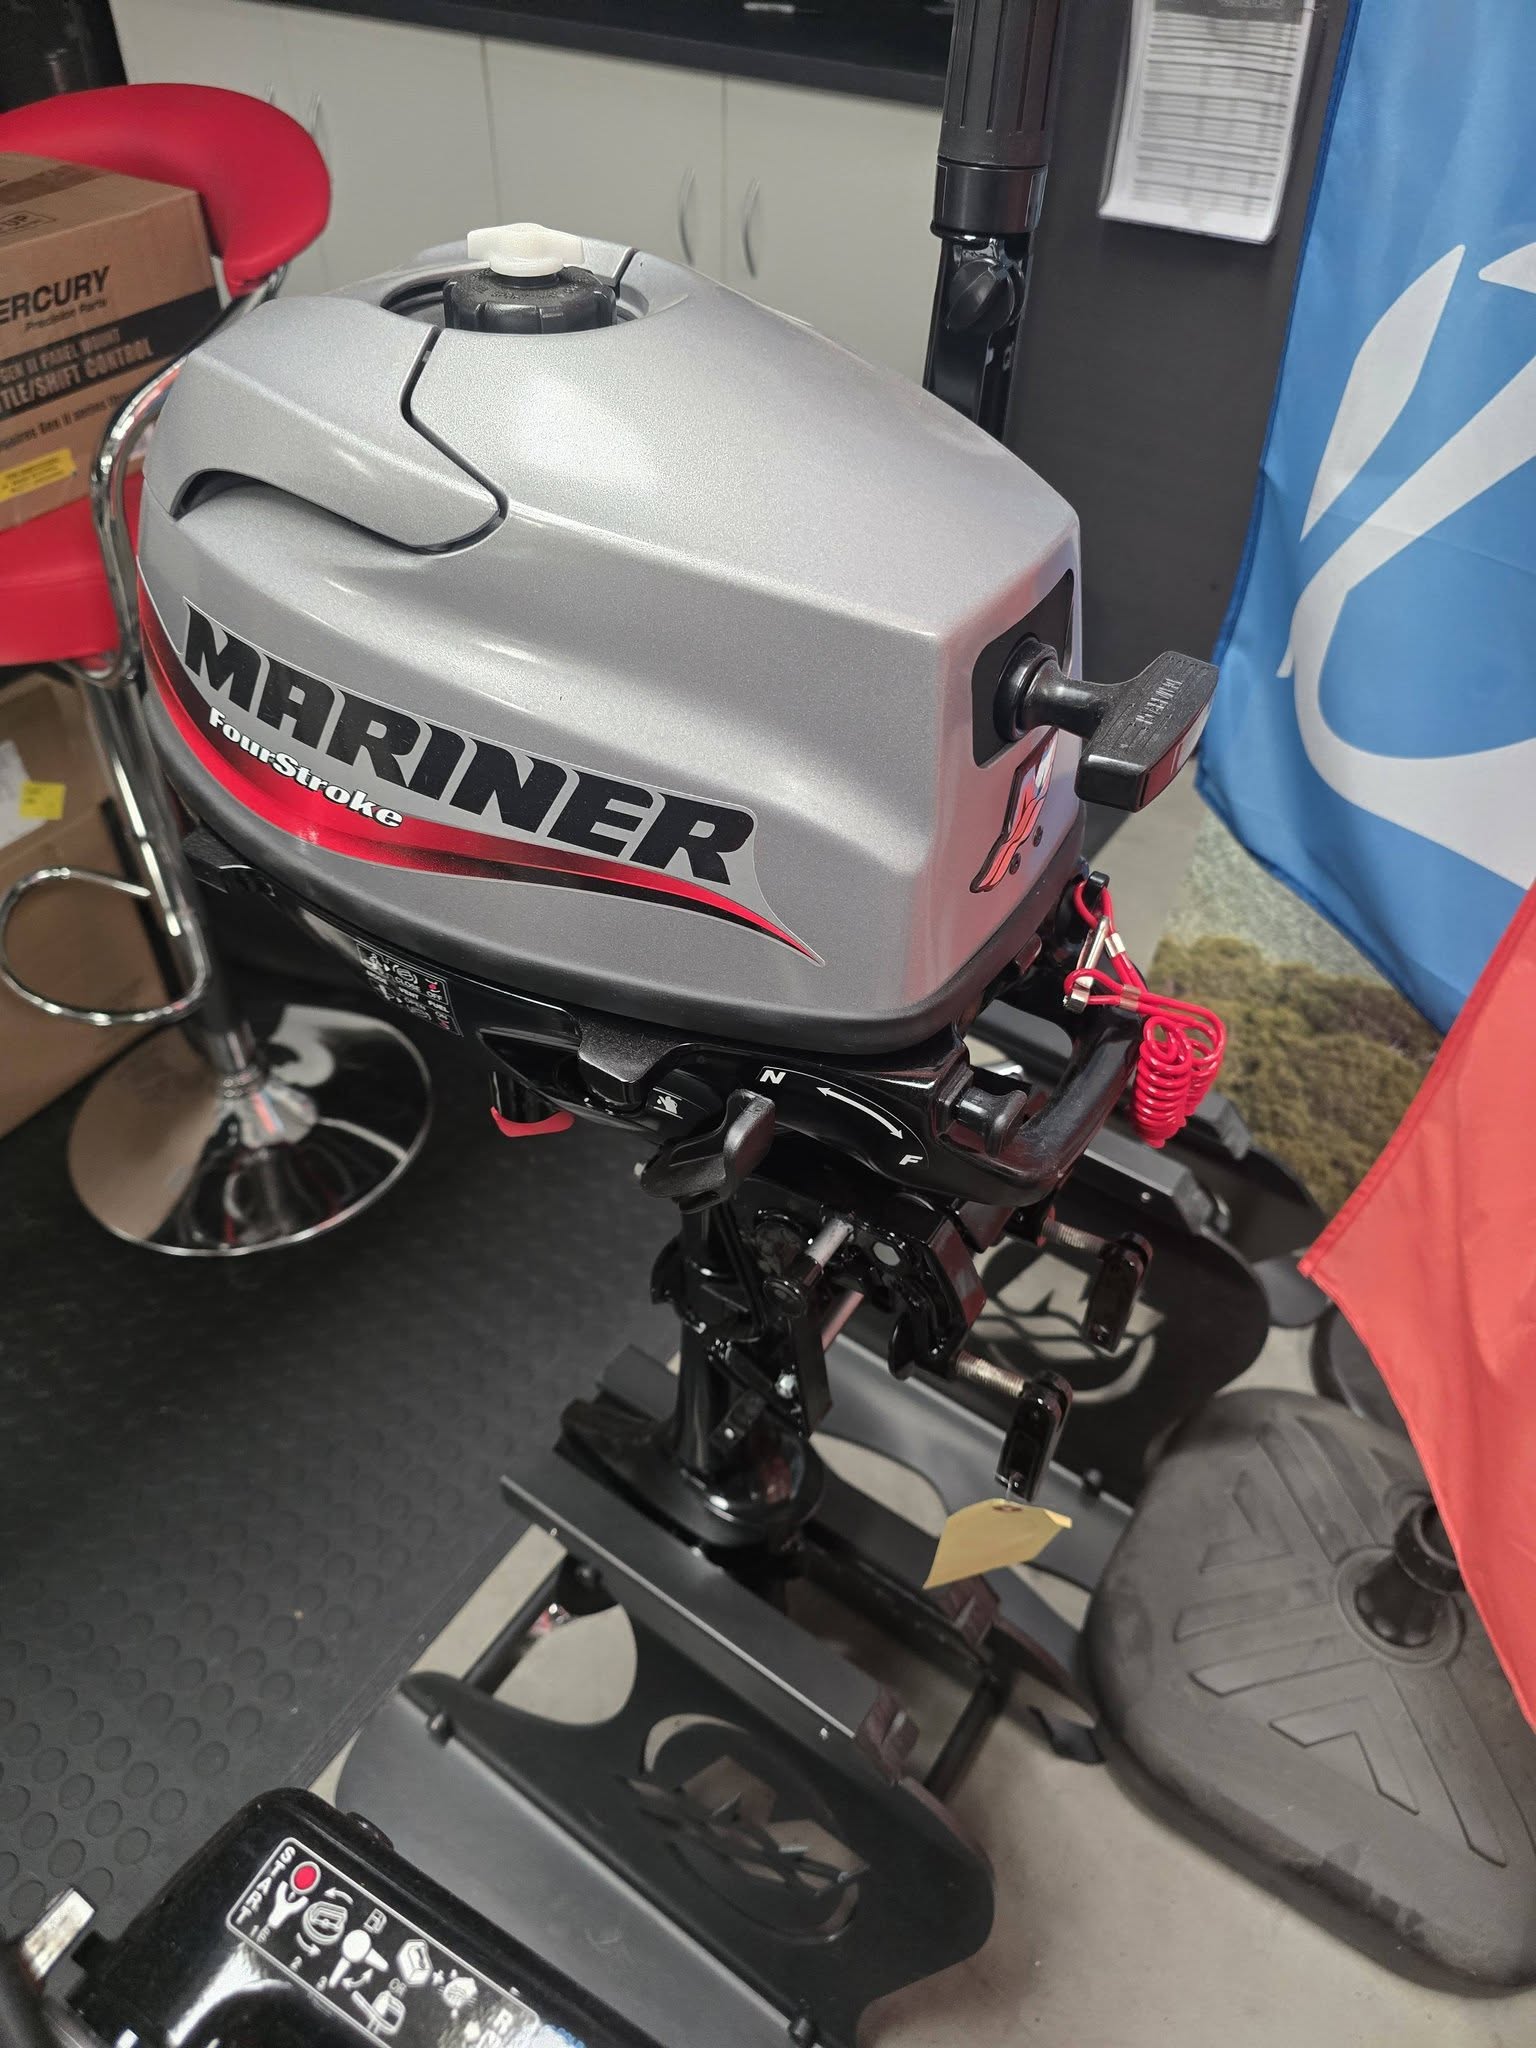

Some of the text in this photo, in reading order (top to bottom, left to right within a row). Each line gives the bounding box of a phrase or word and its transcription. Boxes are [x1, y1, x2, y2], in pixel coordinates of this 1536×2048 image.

[84, 337, 153, 380] CONTROL
[184, 605, 755, 885] MARINER
[208, 706, 404, 829] FourStroke
[427, 1000, 450, 1013] FUEL
[759, 1069, 787, 1085] N
[898, 1153, 924, 1167] F
[234, 1845, 297, 1926] START
[289, 1955, 304, 1973] 2
[315, 1975, 329, 1993] 3
[387, 1976, 408, 1999] OR
